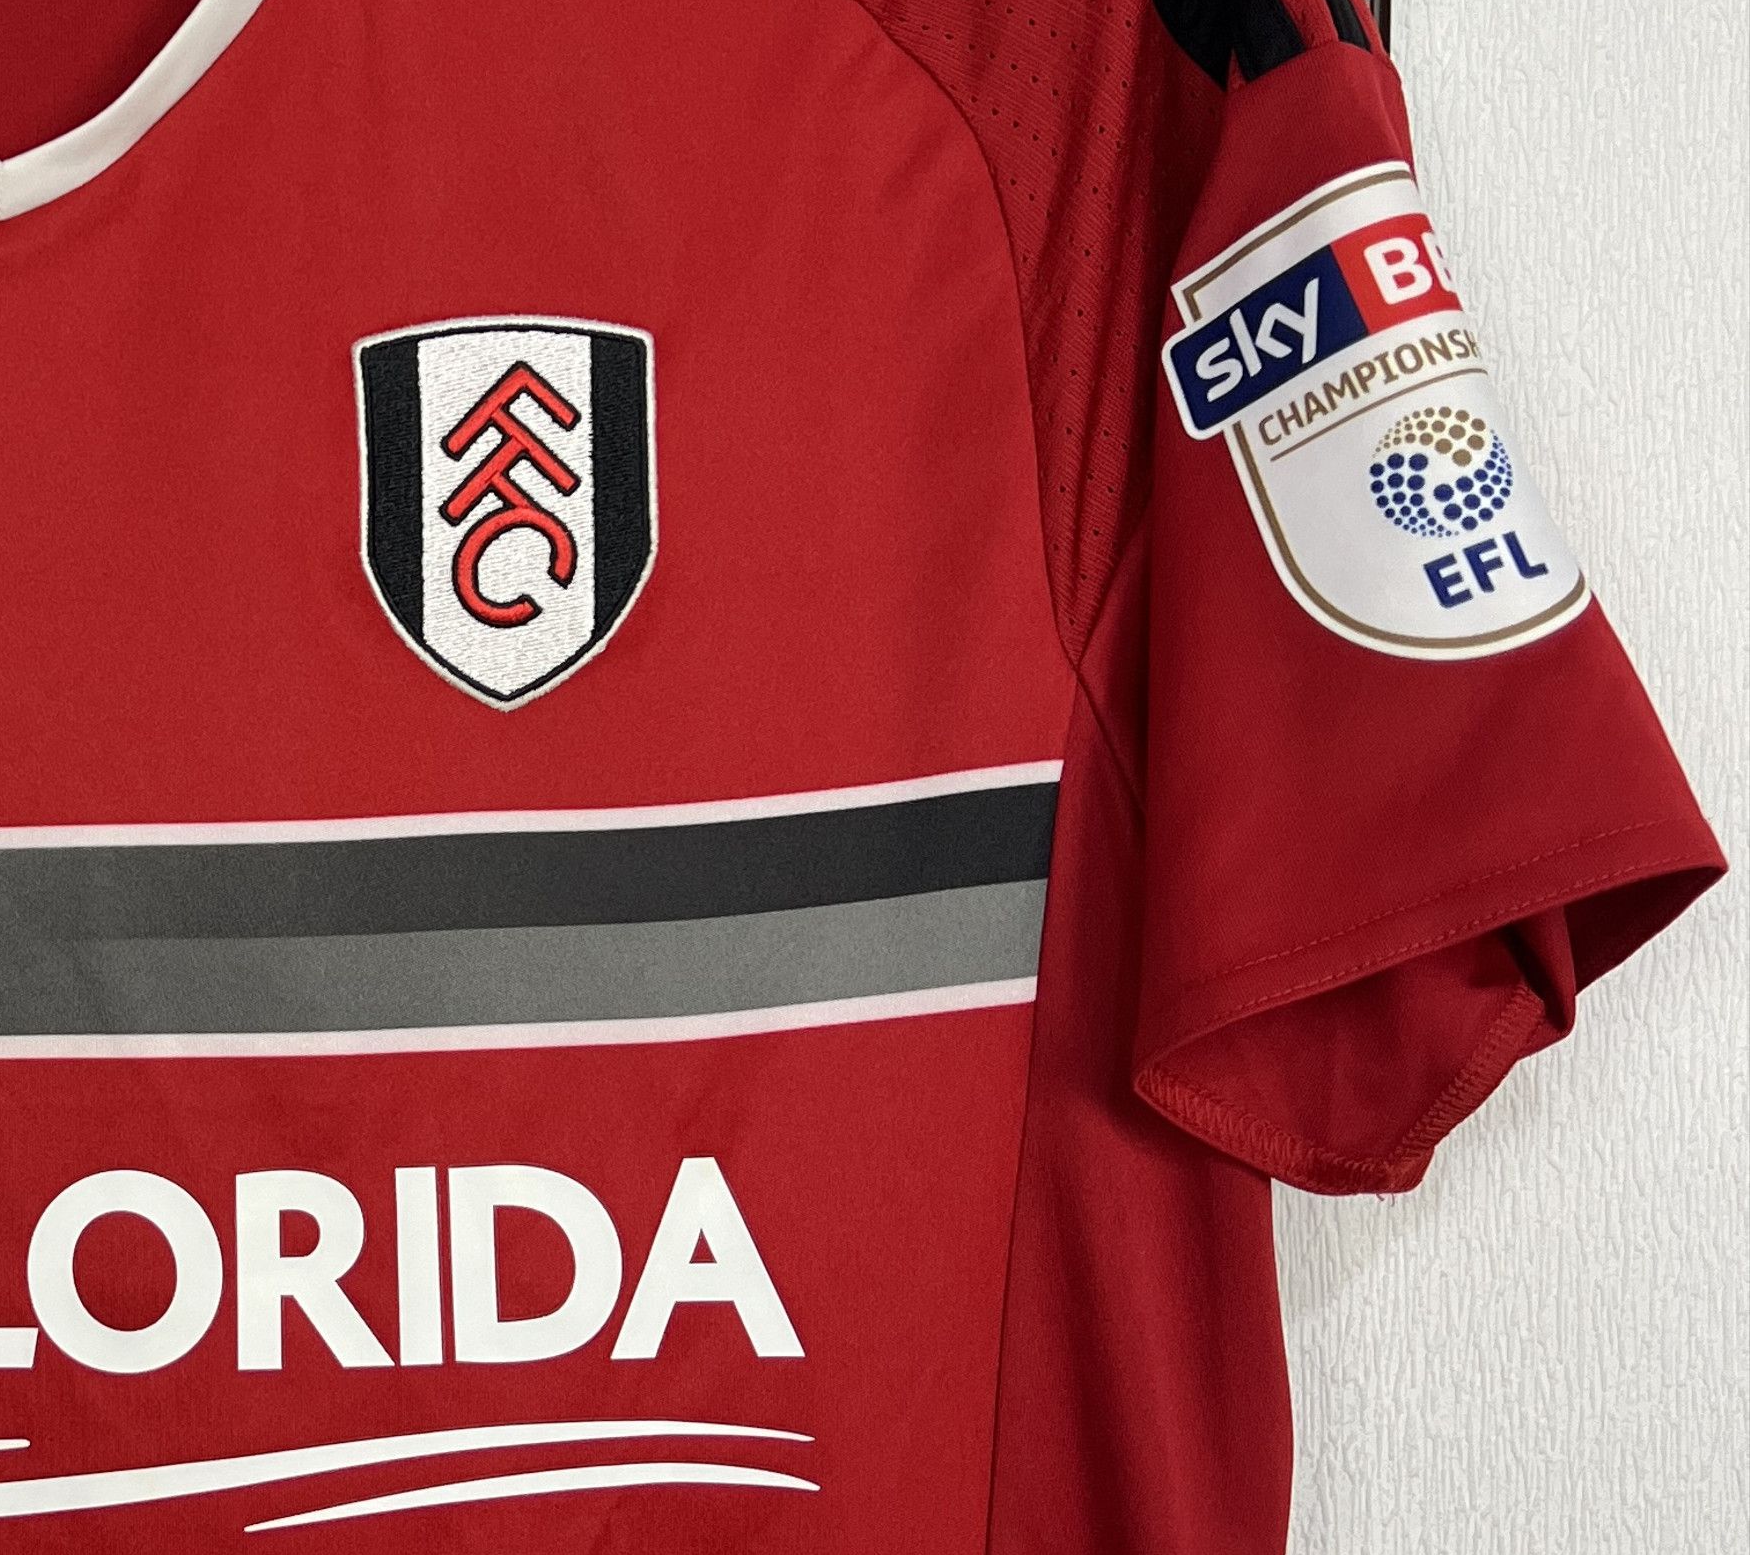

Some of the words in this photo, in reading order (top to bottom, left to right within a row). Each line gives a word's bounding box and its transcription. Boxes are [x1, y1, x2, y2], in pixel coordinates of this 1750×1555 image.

[1193, 276, 1322, 403] sky
[1363, 231, 1455, 306] BE
[1257, 328, 1480, 446] CHAMPIONSH
[1423, 530, 1550, 609] EFL
